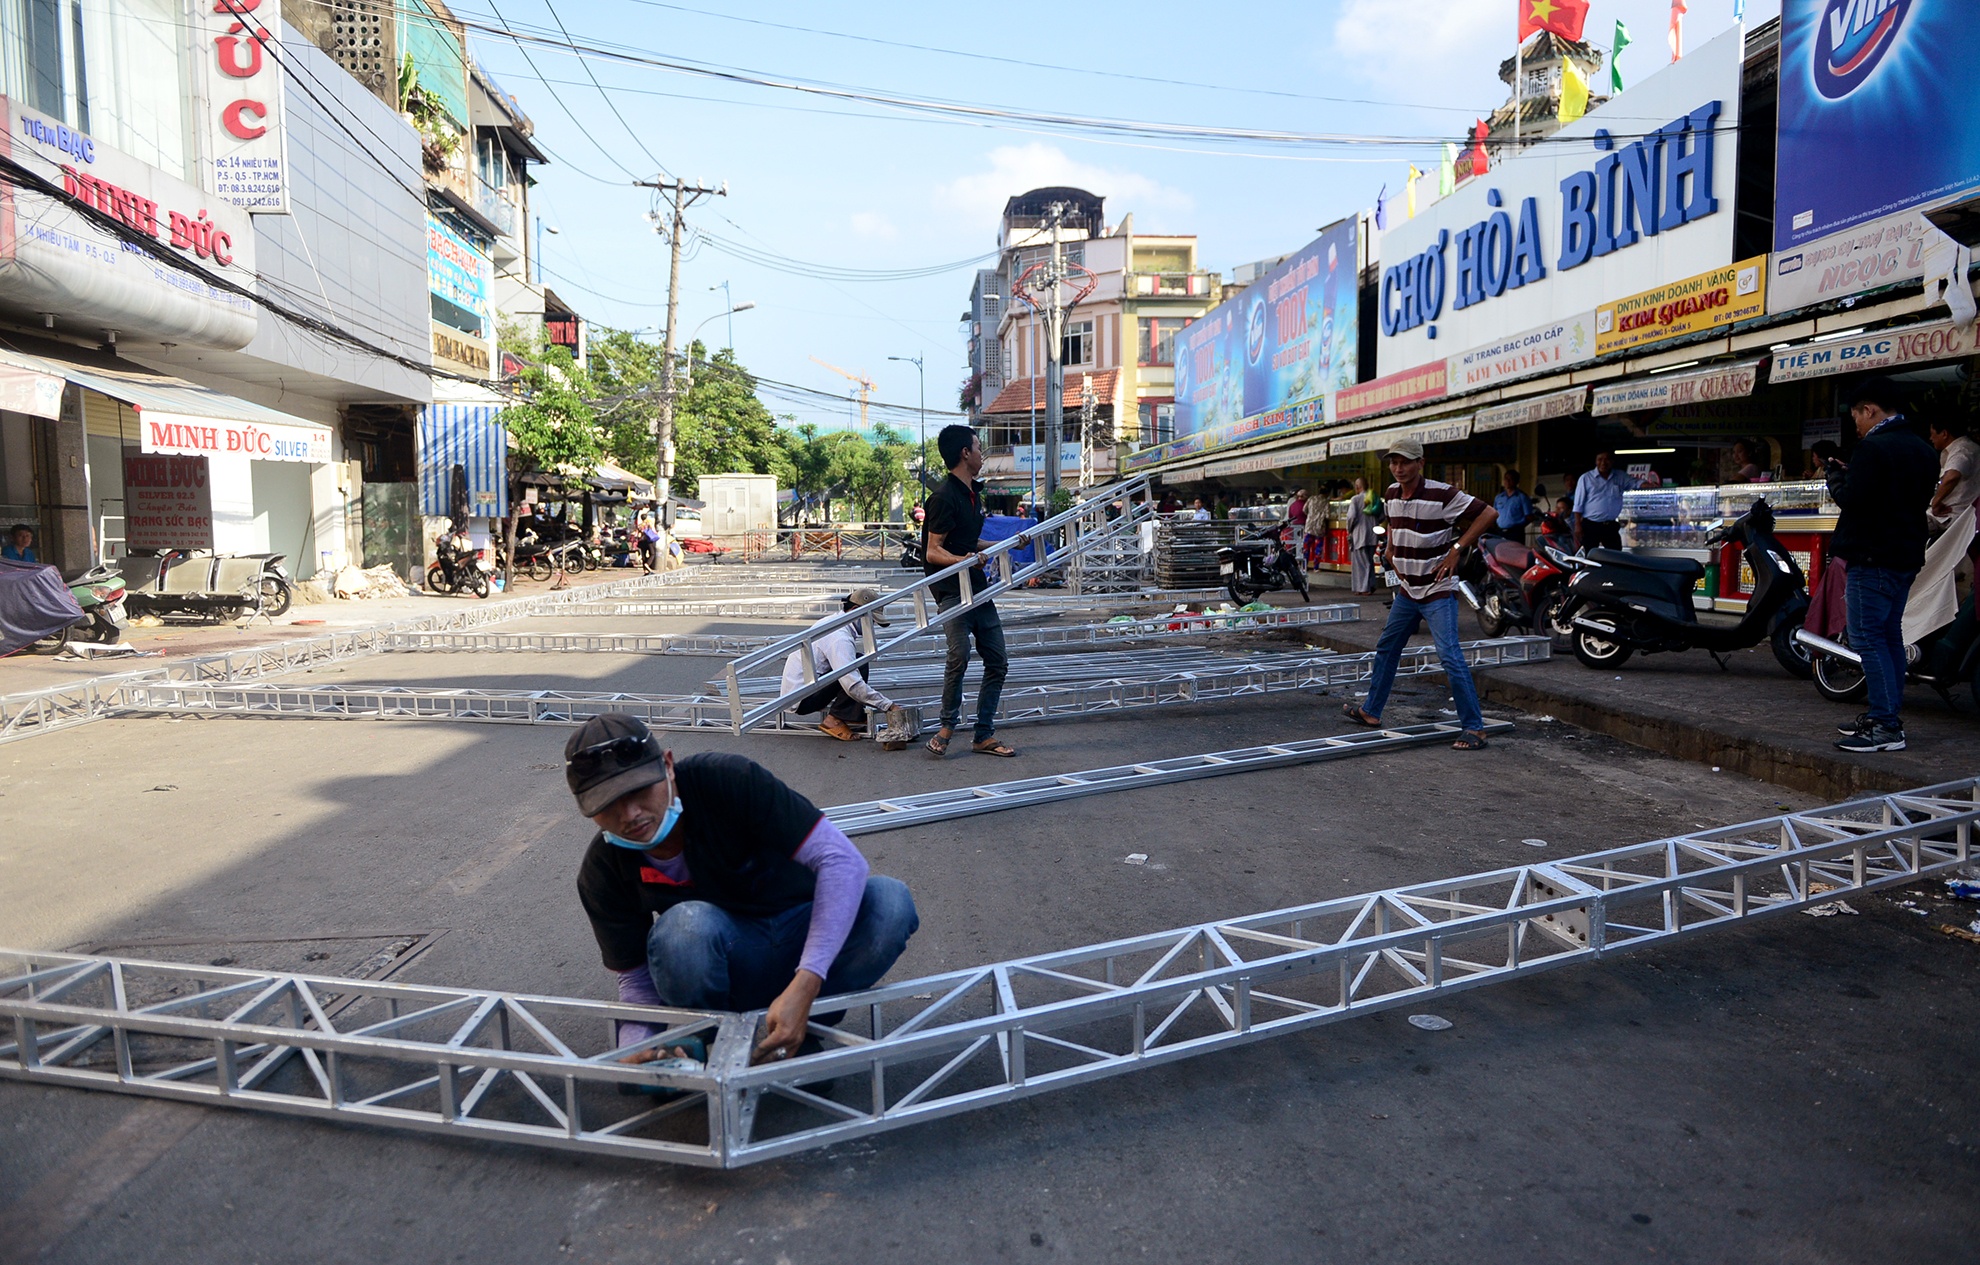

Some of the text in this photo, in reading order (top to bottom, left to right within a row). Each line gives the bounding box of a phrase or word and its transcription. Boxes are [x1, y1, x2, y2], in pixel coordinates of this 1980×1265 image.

[20, 115, 96, 165] TIỆM BẠC
[217, 171, 279, 182] P.5 Q.5 TP.HCM
[229, 156, 240, 168] 14
[263, 157, 278, 168] TÂM
[61, 163, 160, 240] MINH
[168, 208, 234, 267] ĐỨC
[1380, 100, 1722, 340] CHỢ HÒA BÌNH
[1818, 246, 1902, 293] NGỌC
[1617, 268, 1736, 315] DNTN KINH DOANH VÀNG
[1275, 284, 1309, 348] 100X
[1618, 287, 1730, 333] KIM QUANG
[1476, 345, 1502, 360] TRANG
[1503, 340, 1521, 353] BẠC
[1523, 333, 1541, 347] CAO
[1544, 325, 1564, 340] CẤP
[1777, 351, 1831, 371] TIỆM
[1839, 340, 1892, 361] BẠC
[1895, 326, 1961, 362] NGỌC
[1466, 366, 1490, 384] KIM
[1495, 348, 1549, 376] NGUYÊN
[1612, 393, 1627, 403] KINH
[1627, 389, 1649, 401] DOANH
[1650, 384, 1668, 397] VÀNG
[1670, 380, 1697, 402] KIM
[1700, 372, 1751, 400] QUANG
[1263, 411, 1285, 427] KIM
[1427, 423, 1461, 442] NGUYÊN
[149, 422, 219, 450] MINH
[226, 425, 273, 455] ĐỨC
[274, 439, 308, 458] SILVER
[313, 433, 325, 442] 14
[126, 457, 168, 487] MINH
[1020, 455, 1042, 463] NGN
[137, 502, 173, 514] Chuyên
[138, 491, 196, 500] SILVER 92.5
[129, 513, 209, 530] TRANG SỨC BẠC
